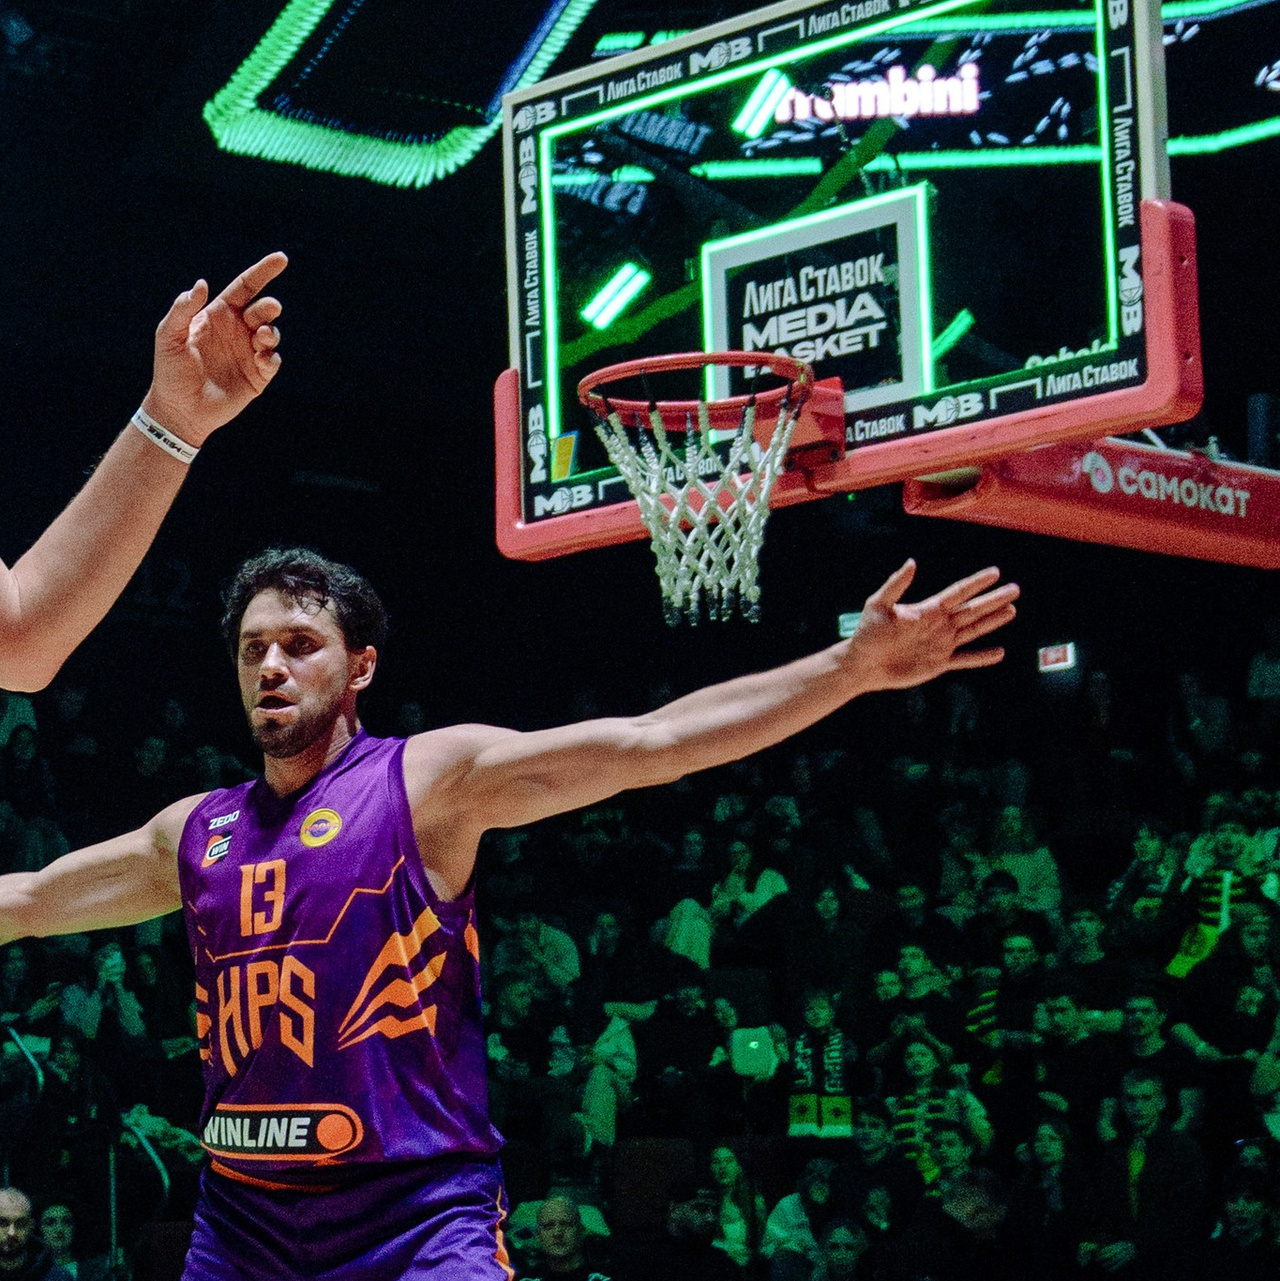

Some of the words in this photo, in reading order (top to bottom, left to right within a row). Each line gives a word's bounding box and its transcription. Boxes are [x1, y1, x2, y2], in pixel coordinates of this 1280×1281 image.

[742, 291, 887, 352] MEDIA
[240, 858, 287, 938] 13
[203, 1114, 310, 1149] WINLINE
